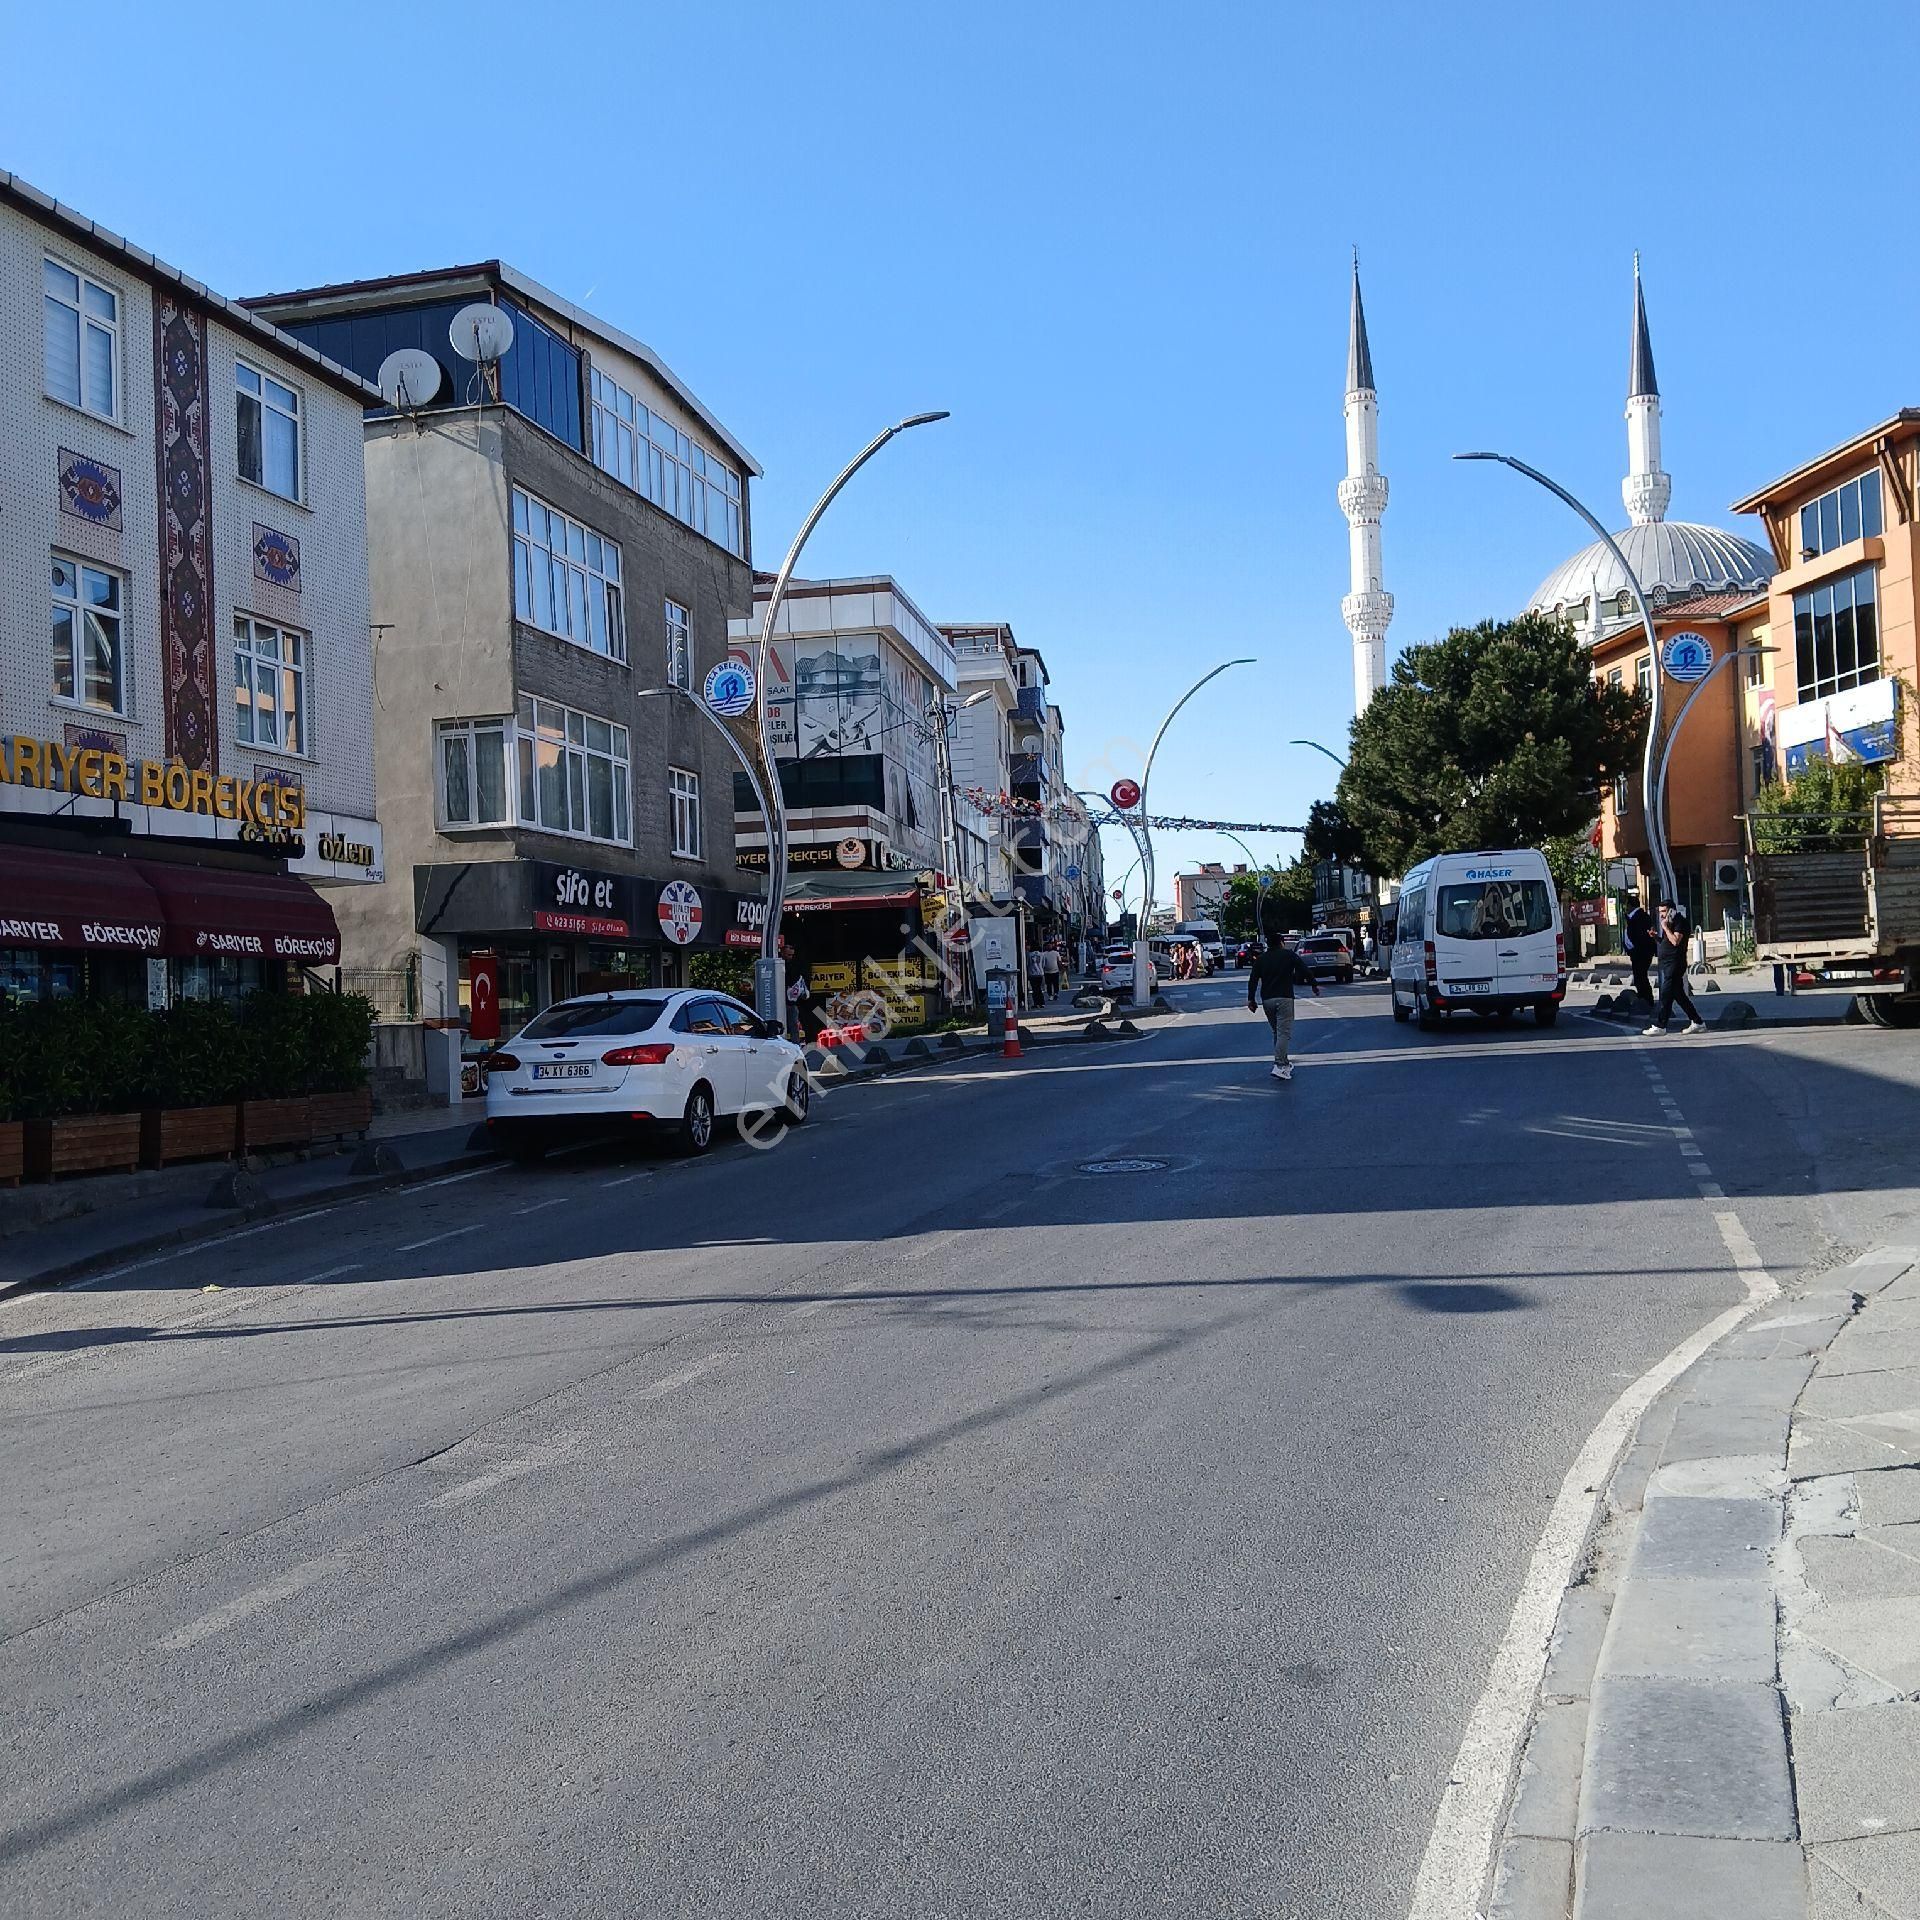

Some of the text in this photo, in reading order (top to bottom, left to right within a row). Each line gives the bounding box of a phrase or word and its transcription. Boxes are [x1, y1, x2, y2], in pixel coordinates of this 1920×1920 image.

[142, 755, 305, 828] BÖREKÇİSİ
[1477, 869, 1512, 879] HASER
[595, 879, 613, 908] et
[0, 919, 63, 941] ARIYER
[209, 933, 335, 959] SARIYER BÖREKÇİSİ
[539, 1065, 590, 1077] 34 XY 6366
